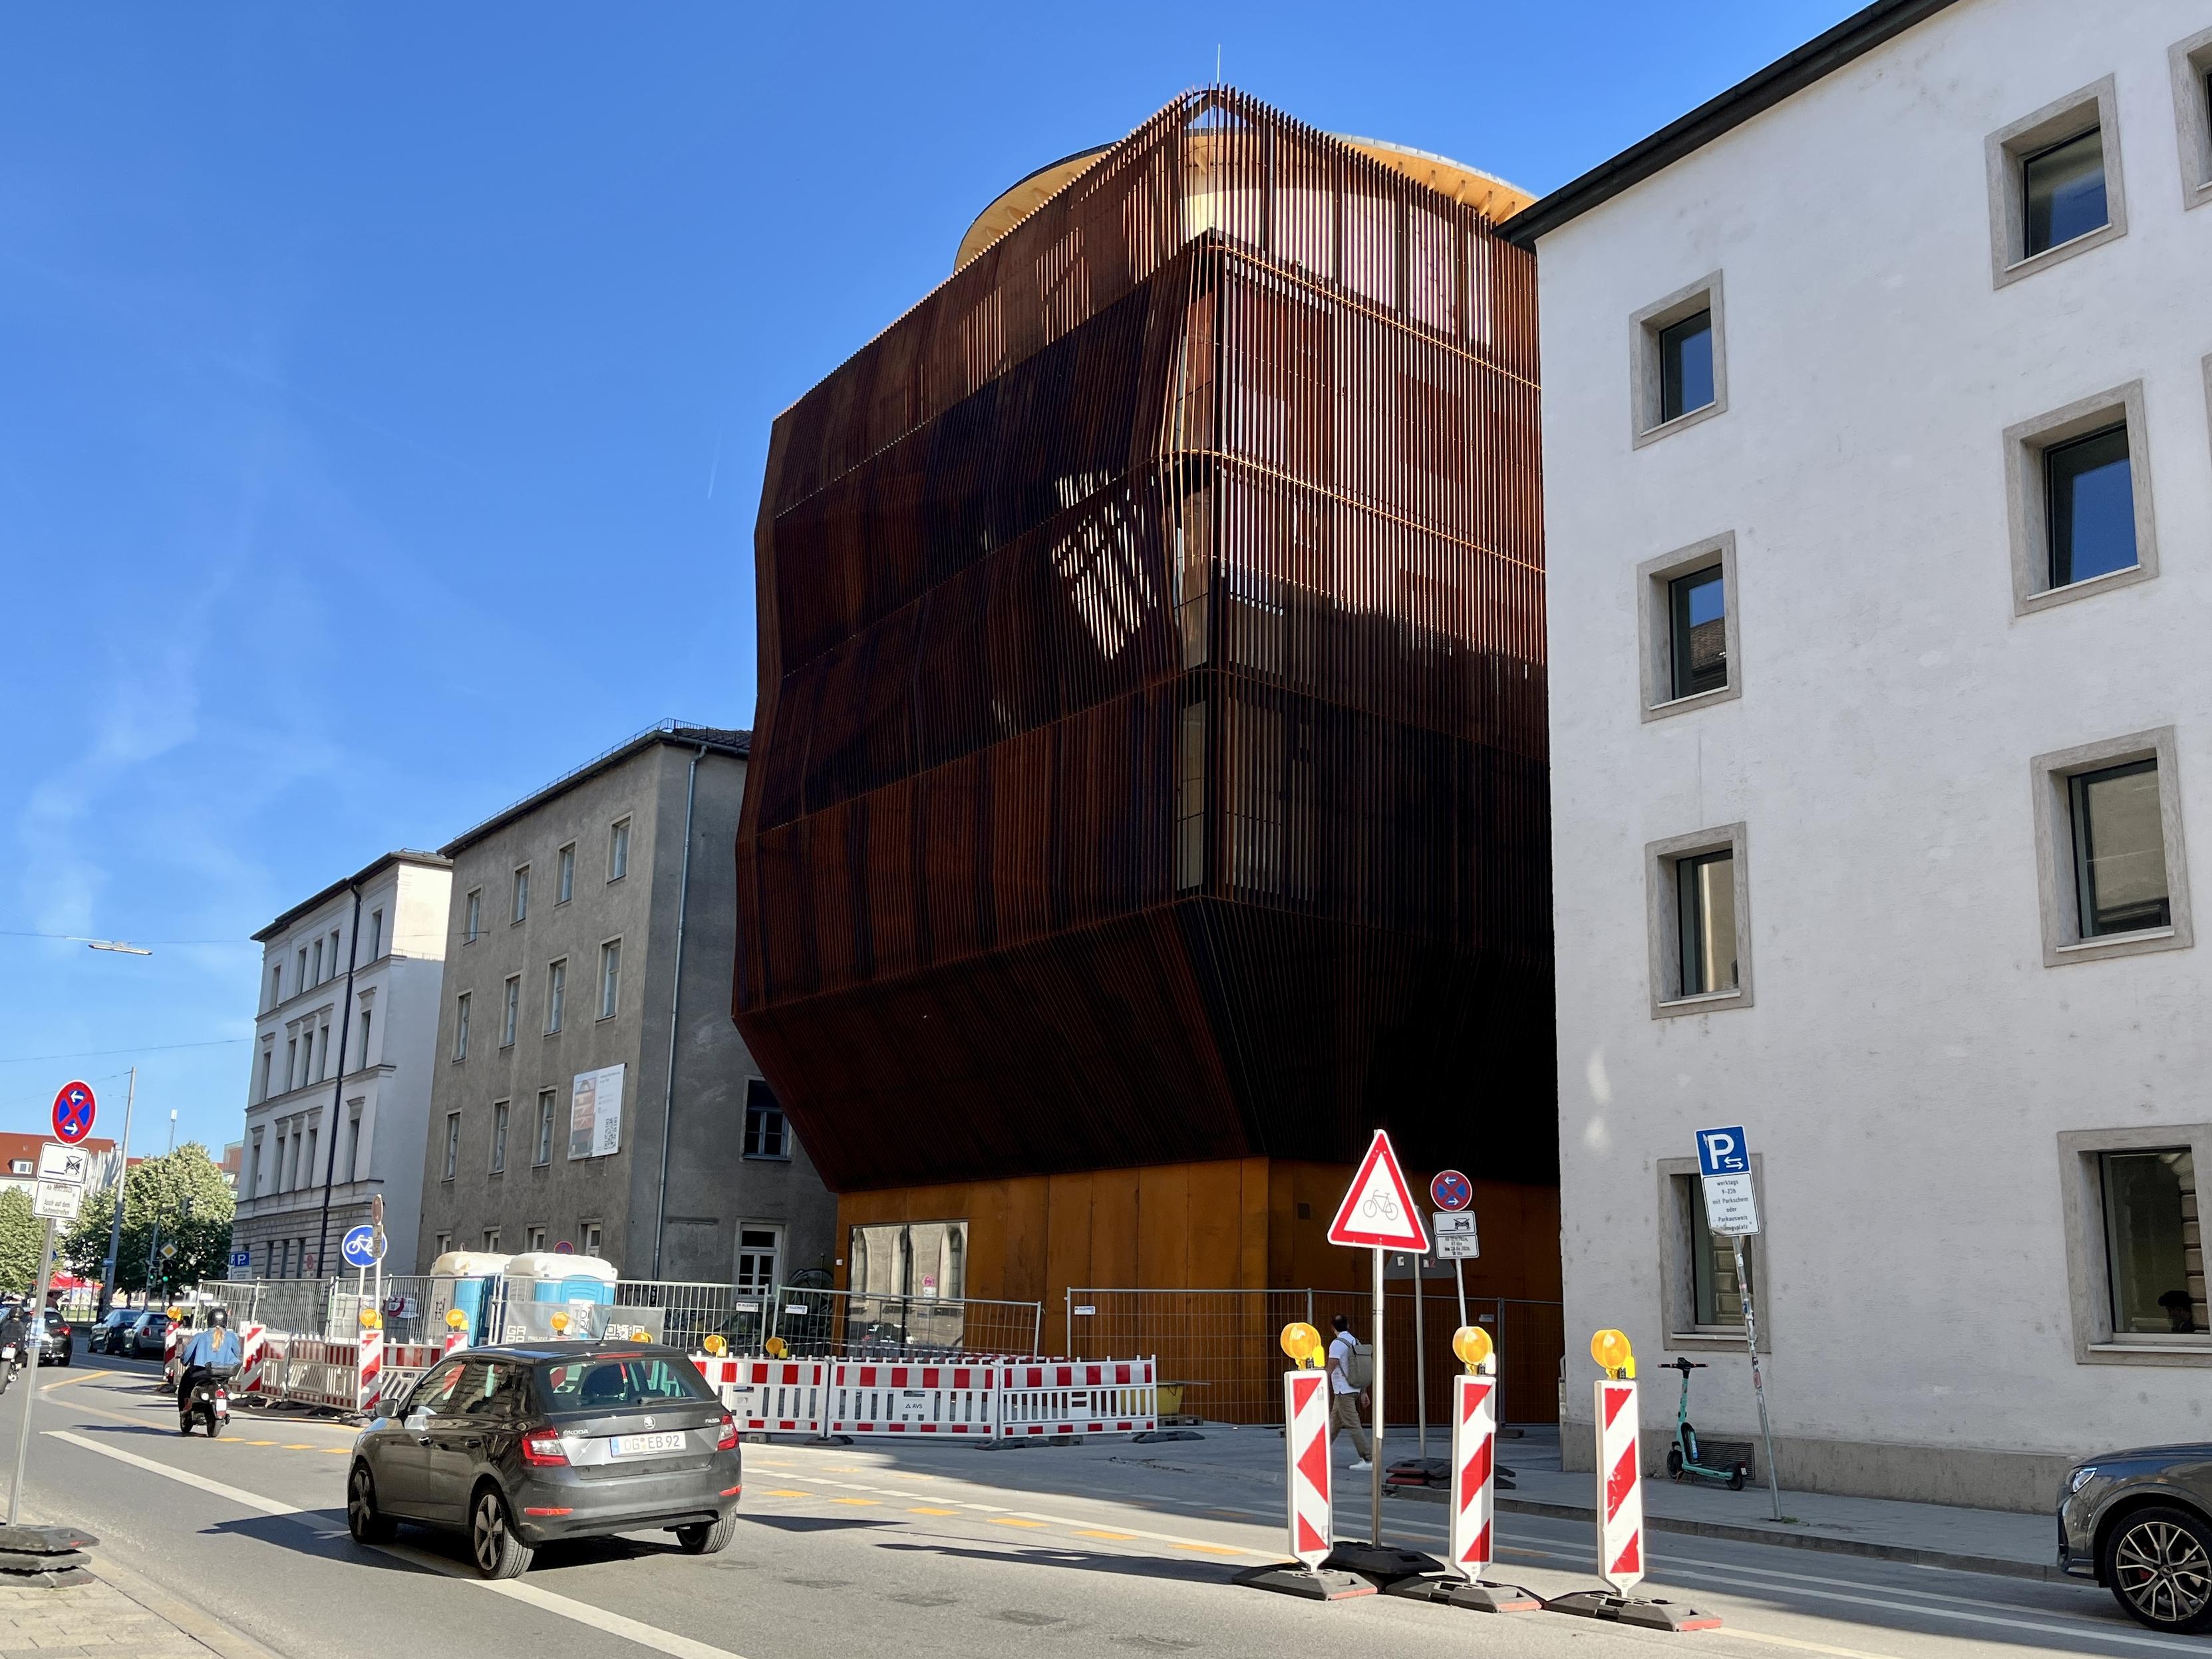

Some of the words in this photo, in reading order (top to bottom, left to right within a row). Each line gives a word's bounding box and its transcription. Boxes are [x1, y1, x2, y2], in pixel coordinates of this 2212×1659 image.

[1708, 1133, 1734, 1169] P
[237, 1254, 246, 1265] P
[624, 1438, 640, 1451] OG
[648, 1436, 663, 1449] EB
[666, 1435, 680, 1447] 92
